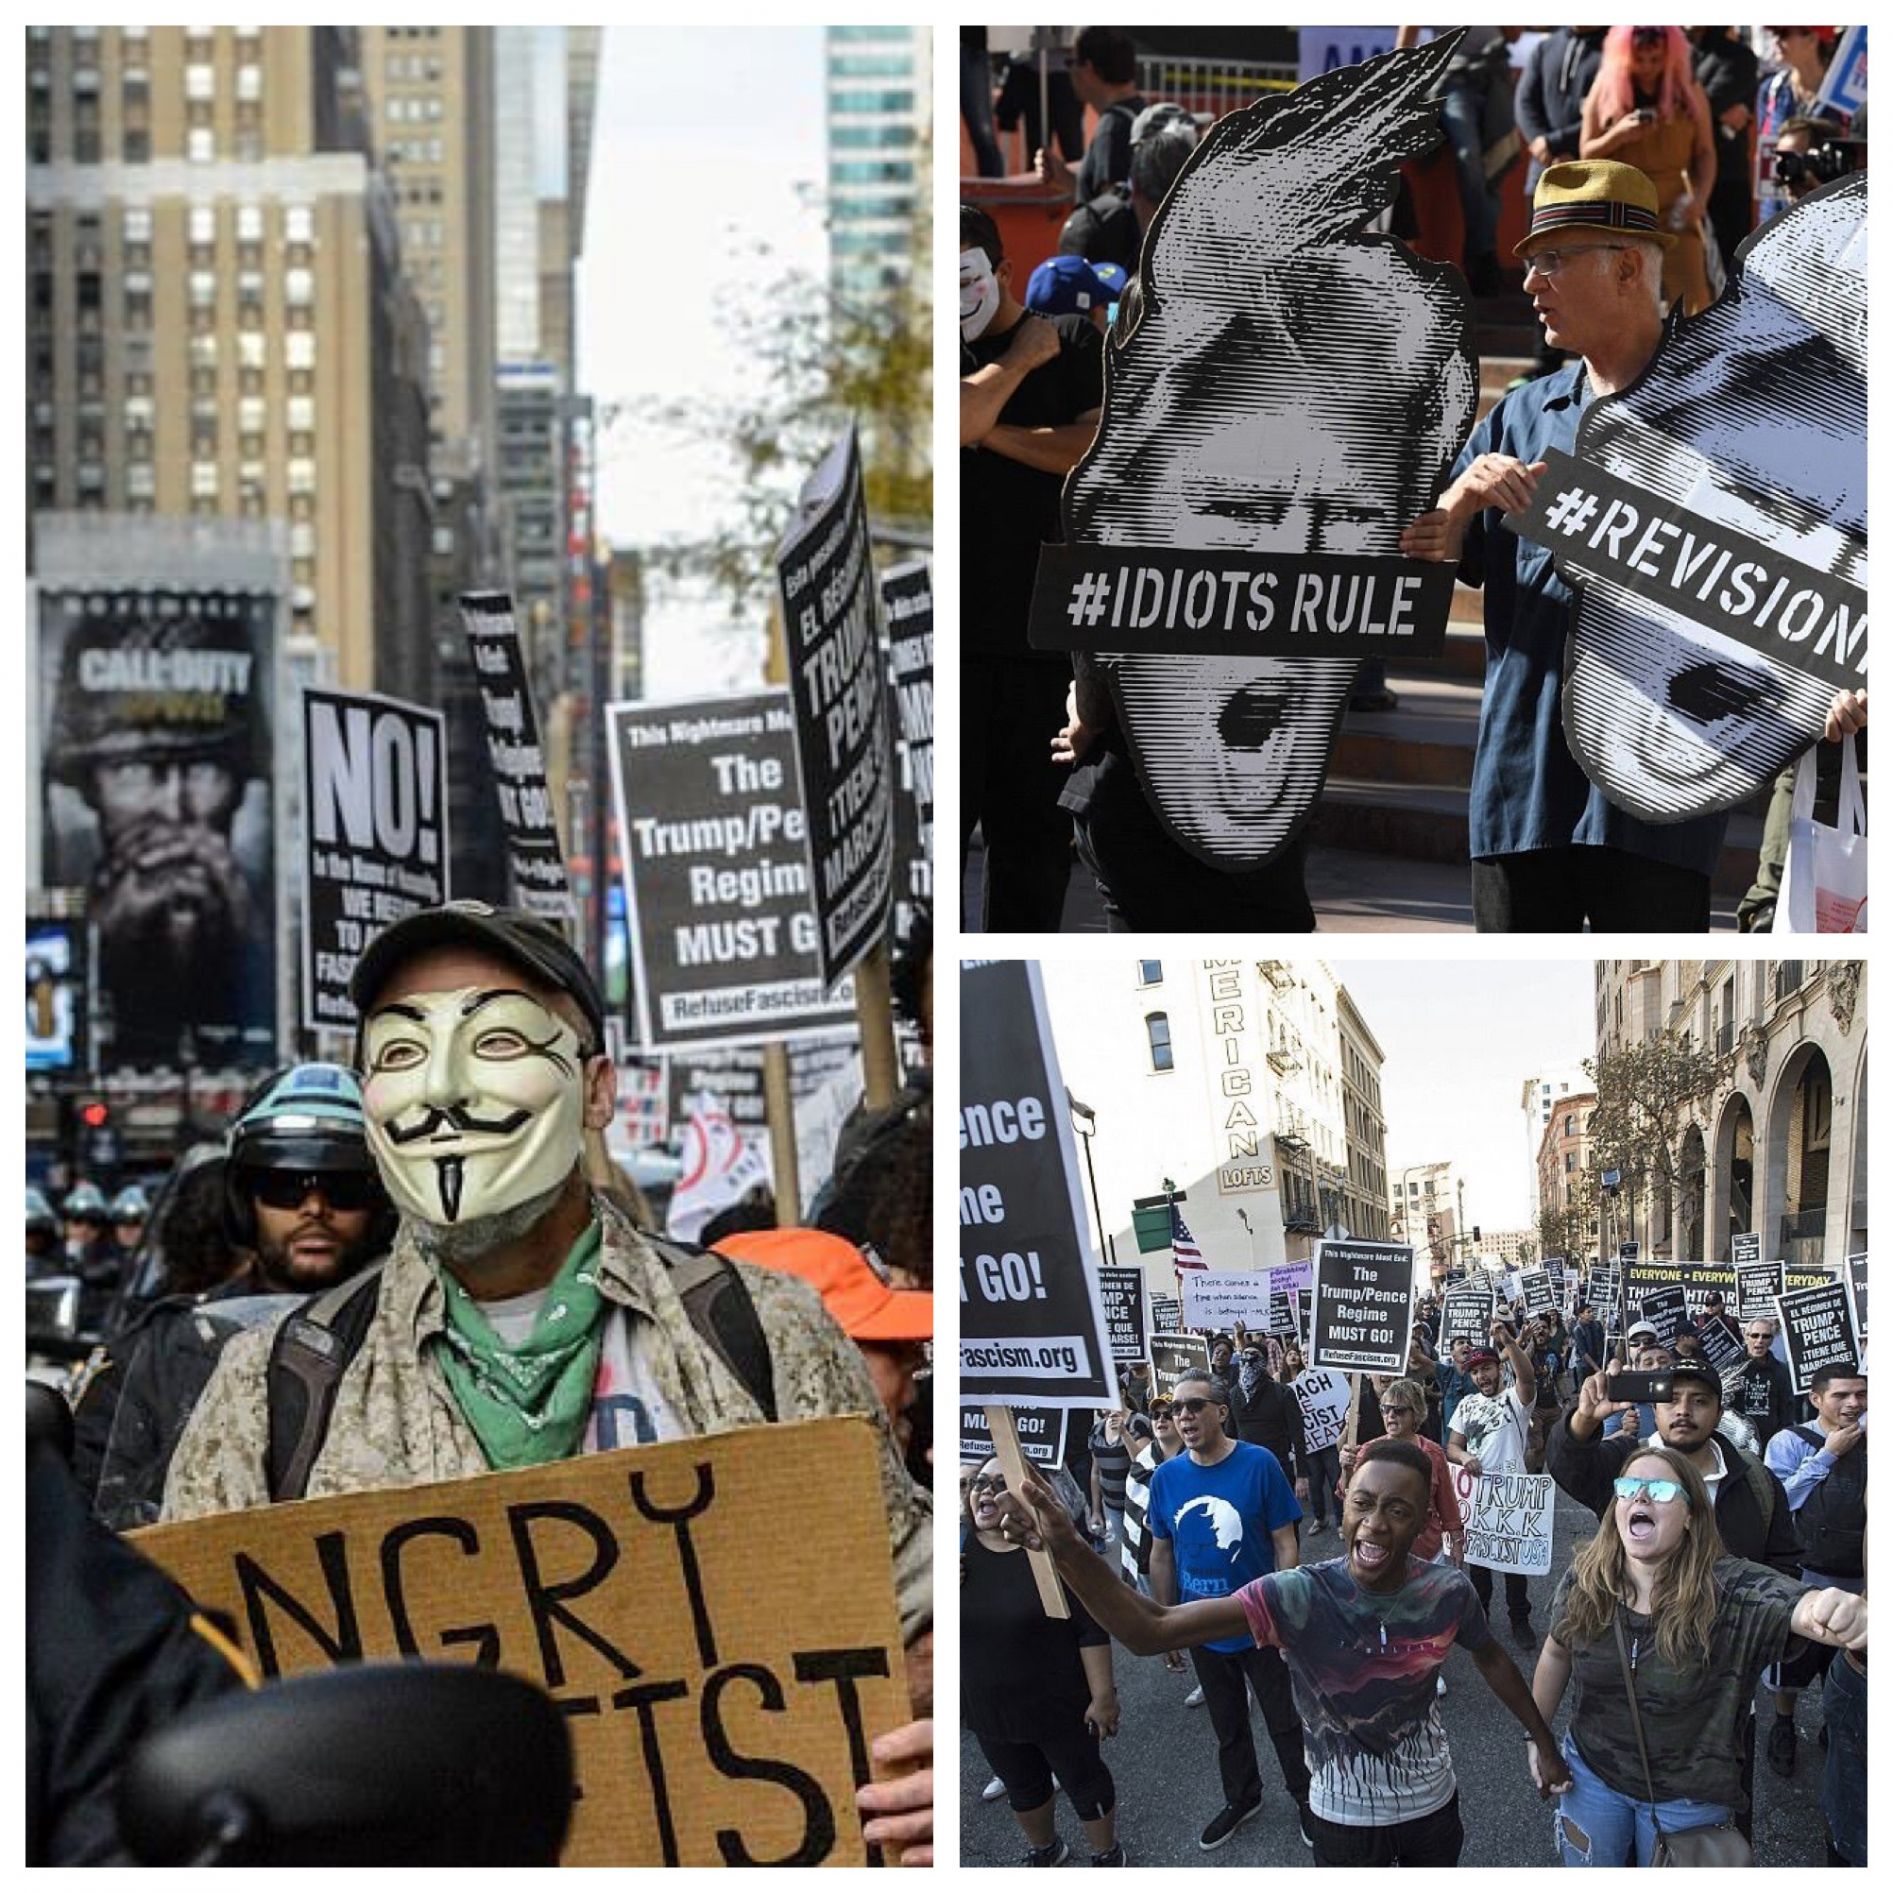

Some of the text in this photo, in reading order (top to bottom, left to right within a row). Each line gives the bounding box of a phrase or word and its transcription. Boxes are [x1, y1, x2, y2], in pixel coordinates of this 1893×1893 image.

[1545, 487, 1867, 675] #REVISION
[1067, 567, 1422, 635] #IDIOTS RULE
[310, 702, 438, 864] NO!
[710, 753, 783, 795] The
[341, 887, 371, 918] WE
[335, 920, 361, 950] TO
[677, 916, 779, 966] MUST
[1222, 1166, 1272, 1188] LOFTS
[975, 1251, 1048, 1302] GO!
[1192, 1275, 1220, 1288] There
[1353, 1266, 1378, 1281] The
[1630, 1268, 1682, 1280] EVERYONE
[1692, 1271, 1736, 1284] EVERYW
[1741, 1279, 1770, 1289] TRUMP
[1127, 1293, 1136, 1305] Y
[1321, 1284, 1408, 1304] Trump/Pence
[1746, 1285, 1773, 1296] PENCE
[1337, 1305, 1388, 1323] Regime
[1448, 1309, 1480, 1319] TRUMP
[1627, 1300, 1641, 1311] TH
[1790, 1309, 1800, 1318] EL
[1833, 1298, 1842, 1308] DE
[1114, 1323, 1133, 1332] QUE
[1452, 1319, 1481, 1328] PENCE
[1791, 1310, 1846, 1333] TRUMP Y
[1328, 1325, 1394, 1344] MUST GO!
[1802, 1325, 1841, 1346] PENCE
[960, 1343, 1078, 1373] ascism.org
[1323, 1350, 1396, 1365] RefuseFascism.org
[1831, 1341, 1847, 1354] QUE
[1174, 1354, 1191, 1368] The
[1295, 1373, 1333, 1400] ACH
[963, 1412, 1046, 1434] MU GO!
[1302, 1404, 1339, 1430] CIST
[1476, 1474, 1552, 1510] TRUMP
[1464, 1529, 1522, 1564] FASCIST
[1522, 1539, 1549, 1566] USA
[234, 1462, 715, 1688] NGRY
[1182, 1569, 1229, 1591] Bern
